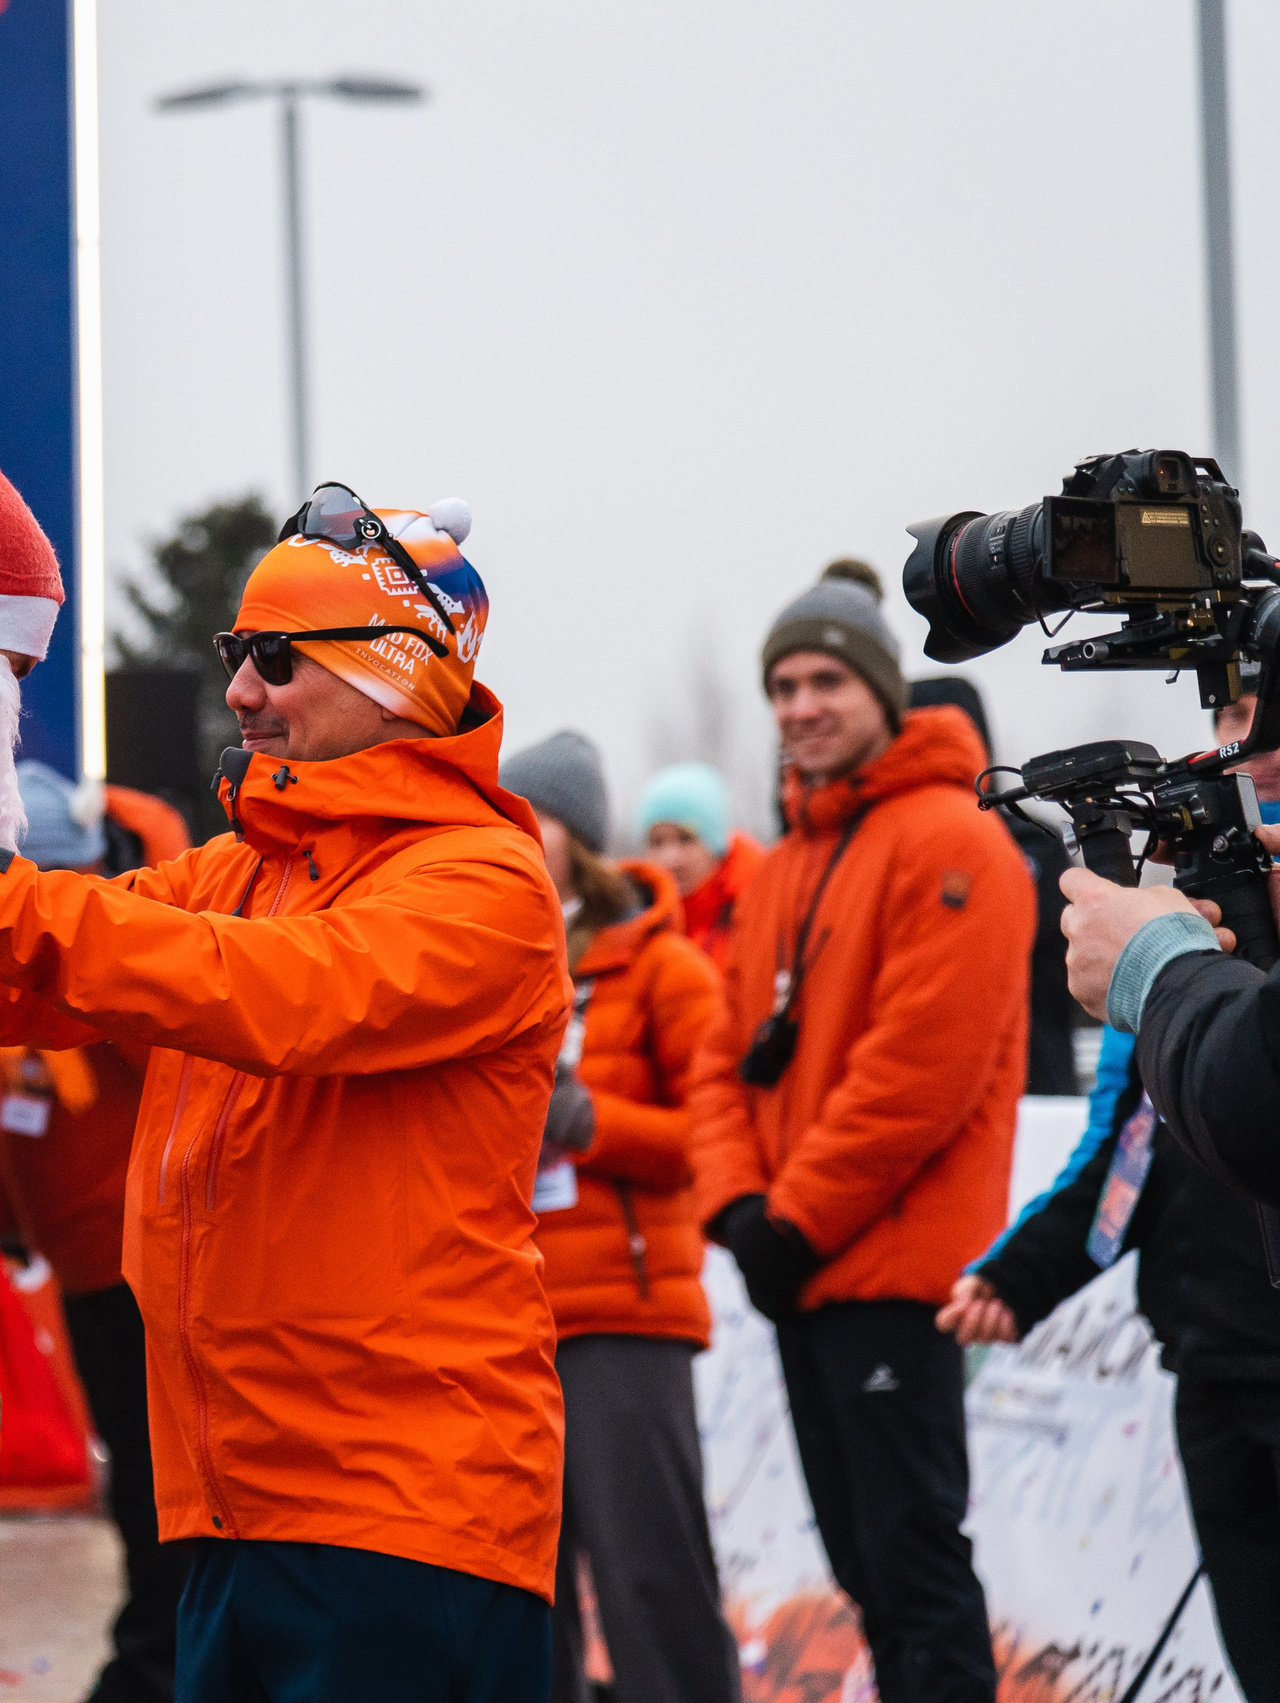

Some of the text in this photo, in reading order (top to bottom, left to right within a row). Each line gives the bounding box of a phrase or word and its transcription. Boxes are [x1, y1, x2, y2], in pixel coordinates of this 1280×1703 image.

[368, 613, 434, 665] MD FOX
[369, 639, 415, 675] ULTRA
[355, 648, 416, 691] INVOCATION
